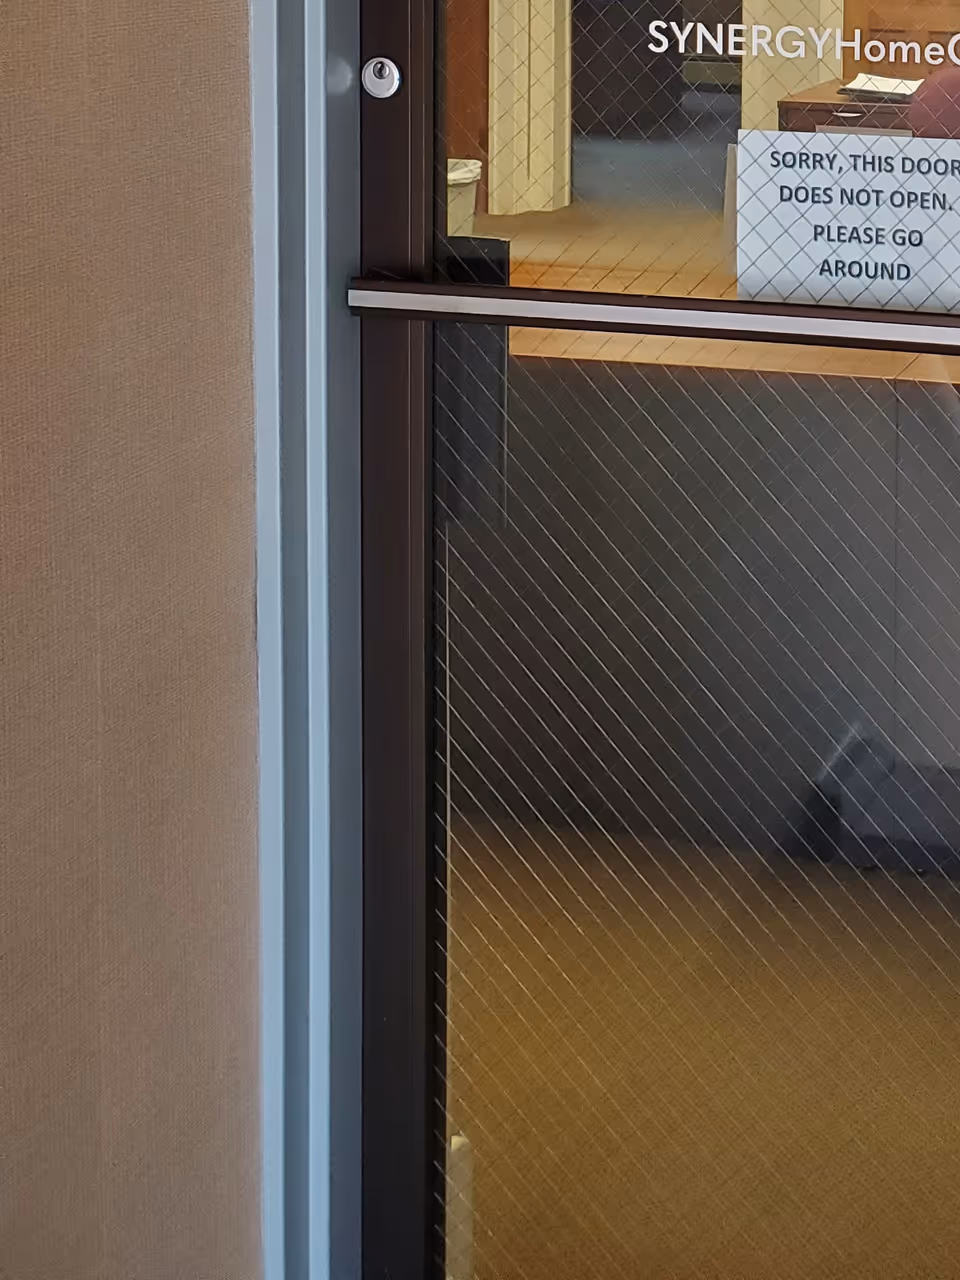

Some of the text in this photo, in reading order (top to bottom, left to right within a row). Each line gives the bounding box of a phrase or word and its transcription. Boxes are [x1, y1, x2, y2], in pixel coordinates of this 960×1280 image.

[770, 150, 843, 174] SORRY,
[850, 154, 895, 173] THIS
[779, 185, 954, 211] DOES NOT OPEN.
[813, 224, 924, 247] PLEASE GO
[818, 258, 911, 281] AROUND
